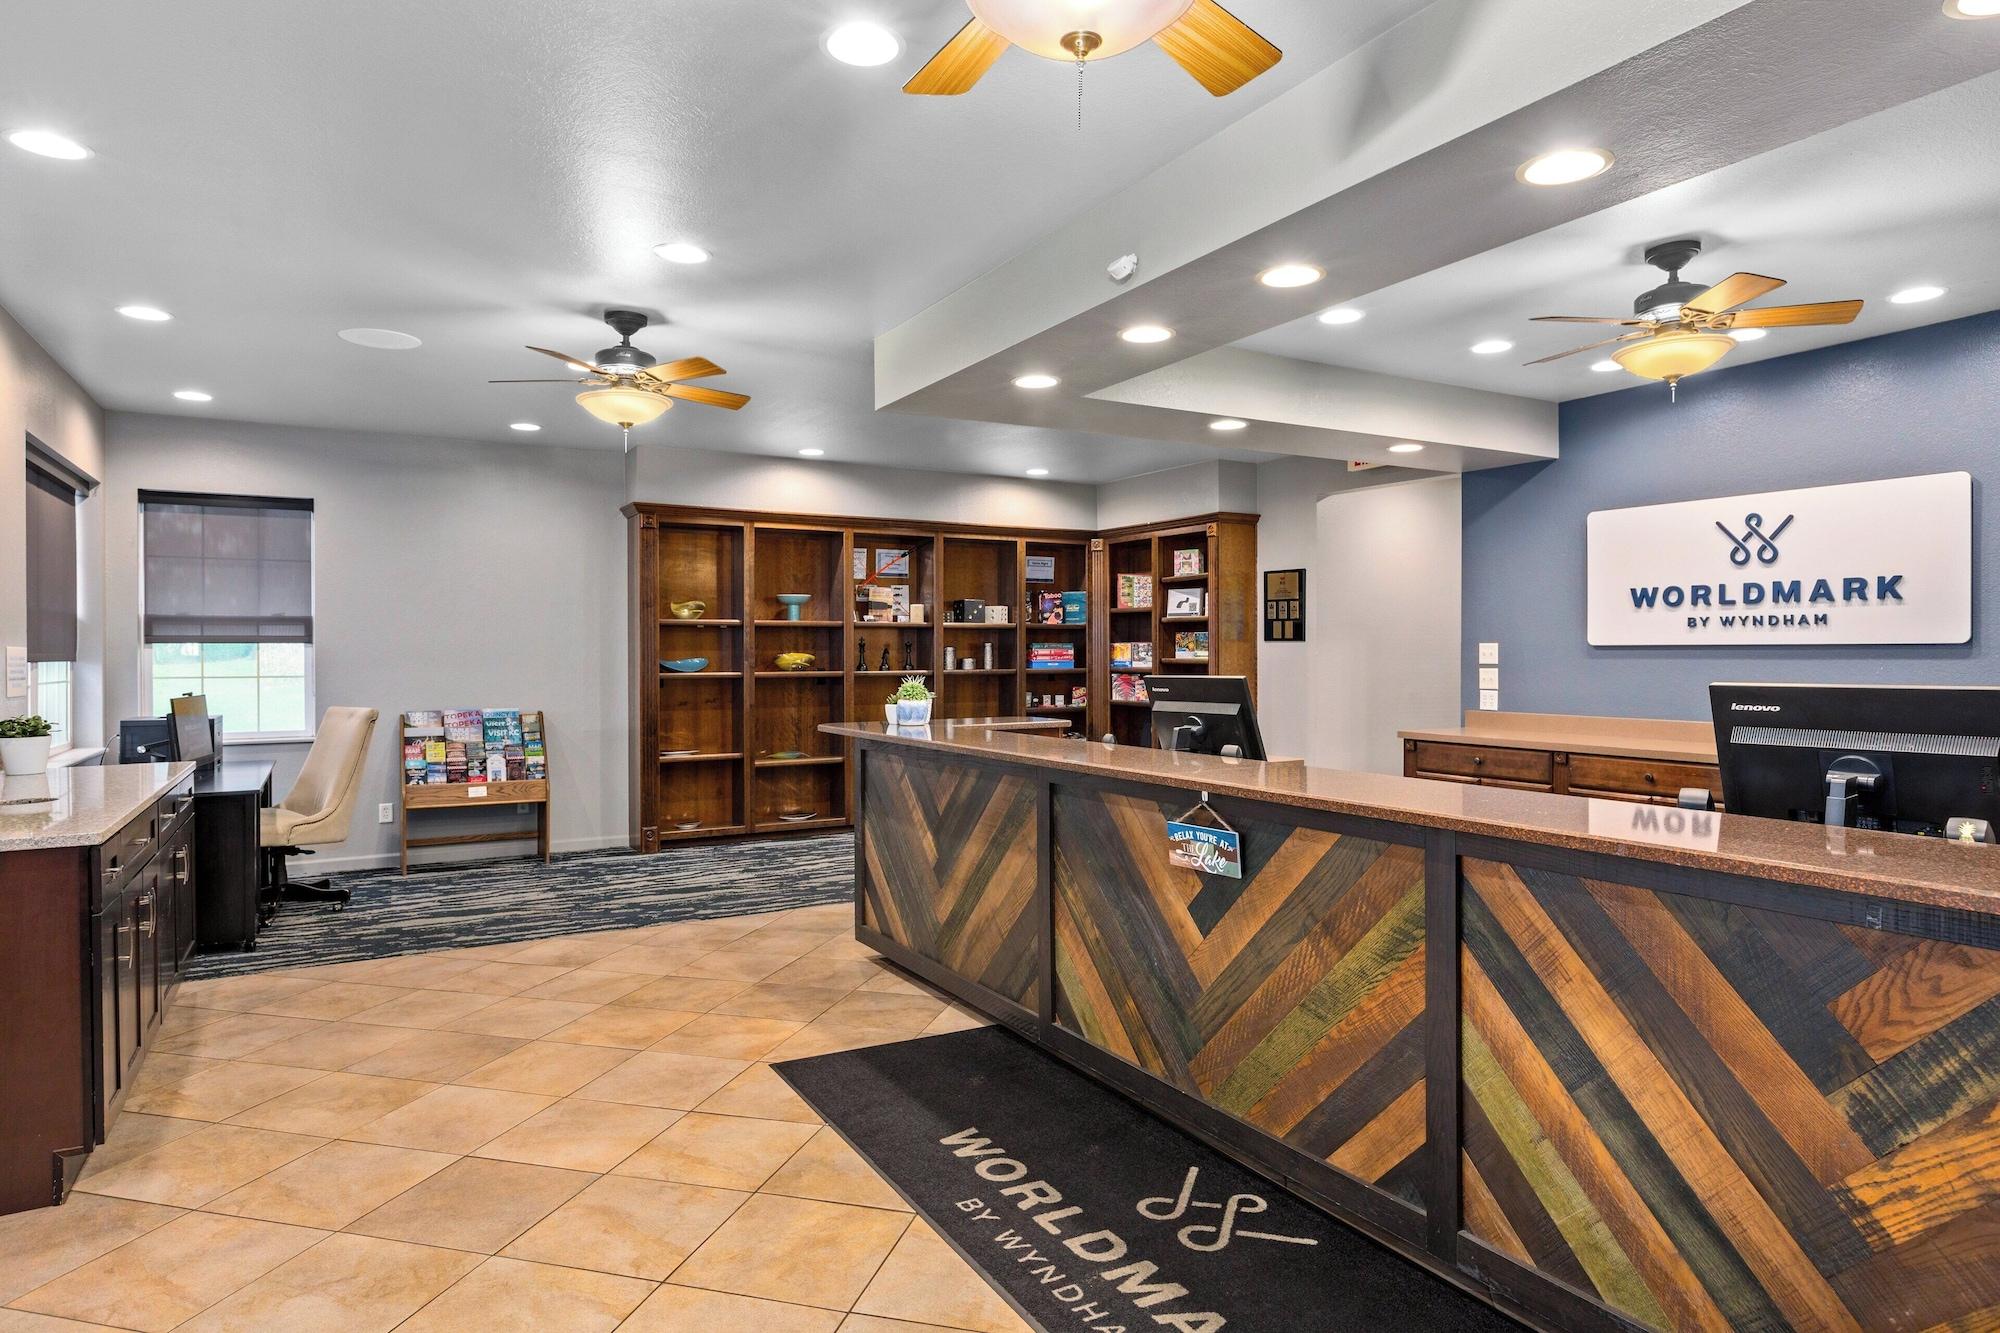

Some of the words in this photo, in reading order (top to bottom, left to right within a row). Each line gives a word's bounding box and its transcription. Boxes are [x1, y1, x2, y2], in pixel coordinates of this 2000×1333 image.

[1630, 575, 1904, 608] WORLDMARK
[1687, 616, 1710, 628] BY
[1720, 613, 1828, 628] WYNDHAM
[444, 710, 481, 719] TOPEKA
[1730, 702, 1781, 712] lenovo
[445, 719, 482, 728] TOPEKA
[1174, 831, 1194, 841] RELAX
[1196, 831, 1218, 844] YOU'RE
[1220, 839, 1230, 851] AT
[1191, 842, 1228, 874] Lake
[955, 1197, 1000, 1221] BY
